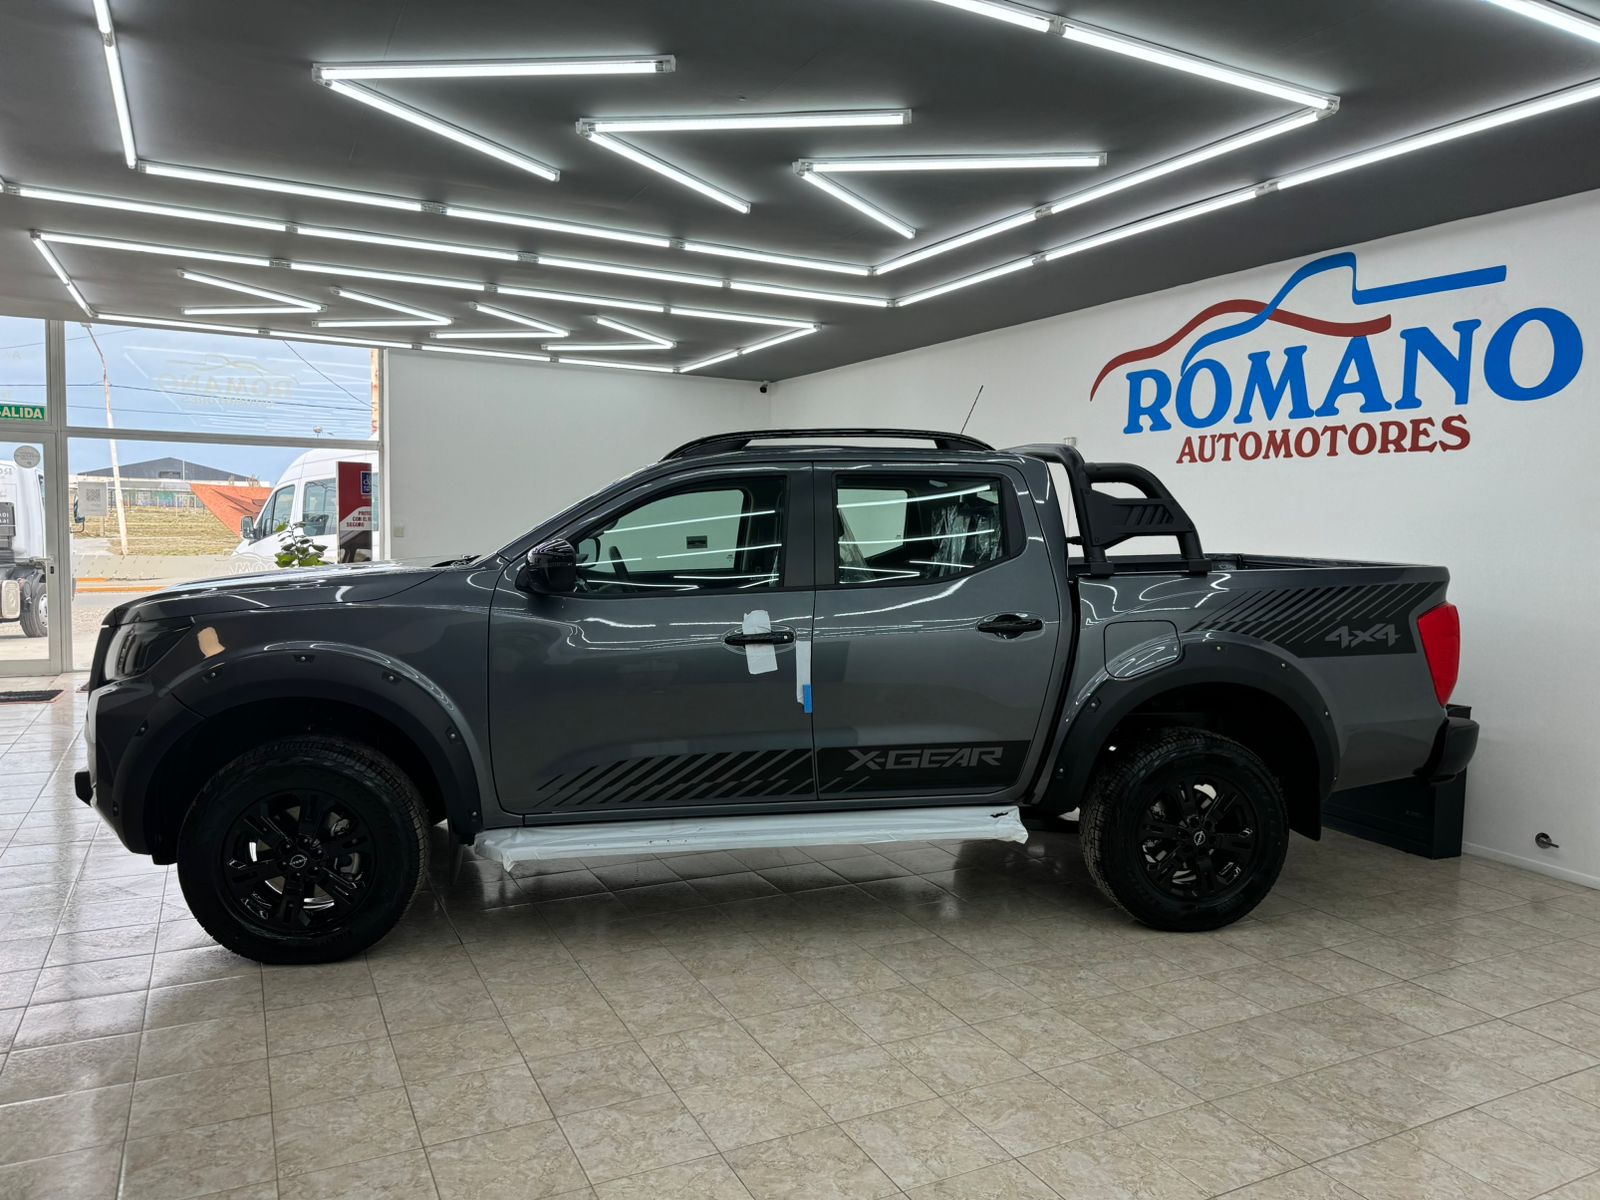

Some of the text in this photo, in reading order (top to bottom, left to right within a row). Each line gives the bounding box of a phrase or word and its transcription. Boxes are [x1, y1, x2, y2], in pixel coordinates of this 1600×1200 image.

[1123, 307, 1583, 434] ROMANO
[0, 407, 42, 418] ALIDA
[1176, 414, 1471, 464] AUTOMOTORES
[1324, 623, 1401, 649] 4x4
[845, 746, 1003, 771] X-GEAR
